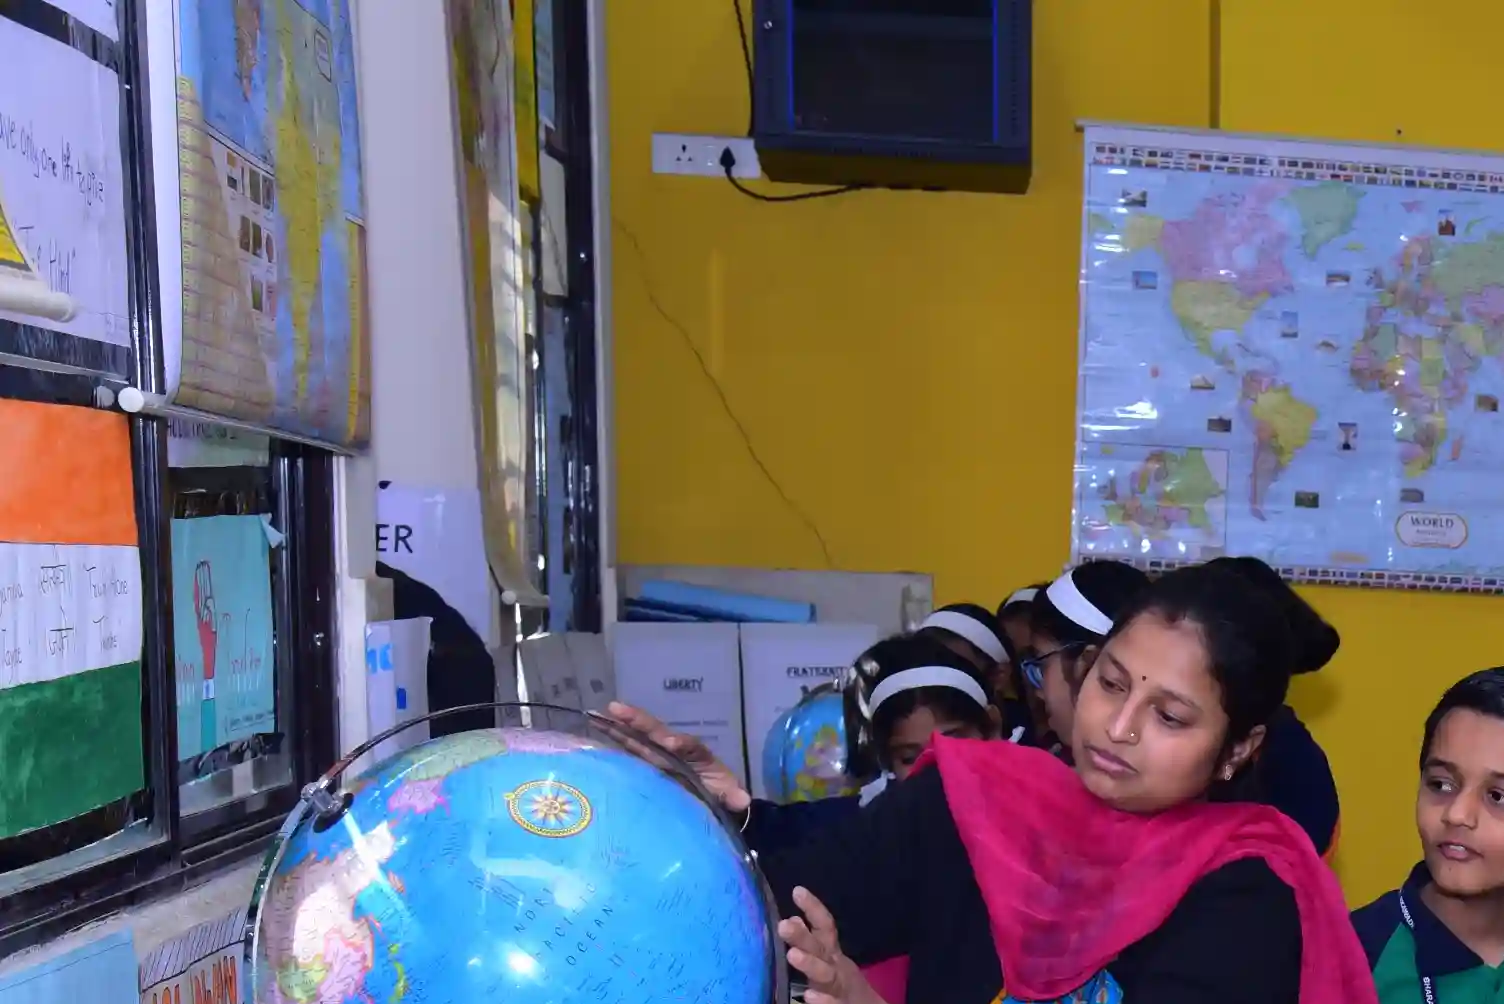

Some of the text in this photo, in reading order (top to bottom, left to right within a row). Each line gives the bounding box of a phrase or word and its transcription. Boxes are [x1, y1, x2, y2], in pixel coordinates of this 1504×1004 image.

[1410, 515, 1454, 529] WORLD
[663, 678, 704, 691] LIBERTY
[565, 904, 614, 966] OCEAN
